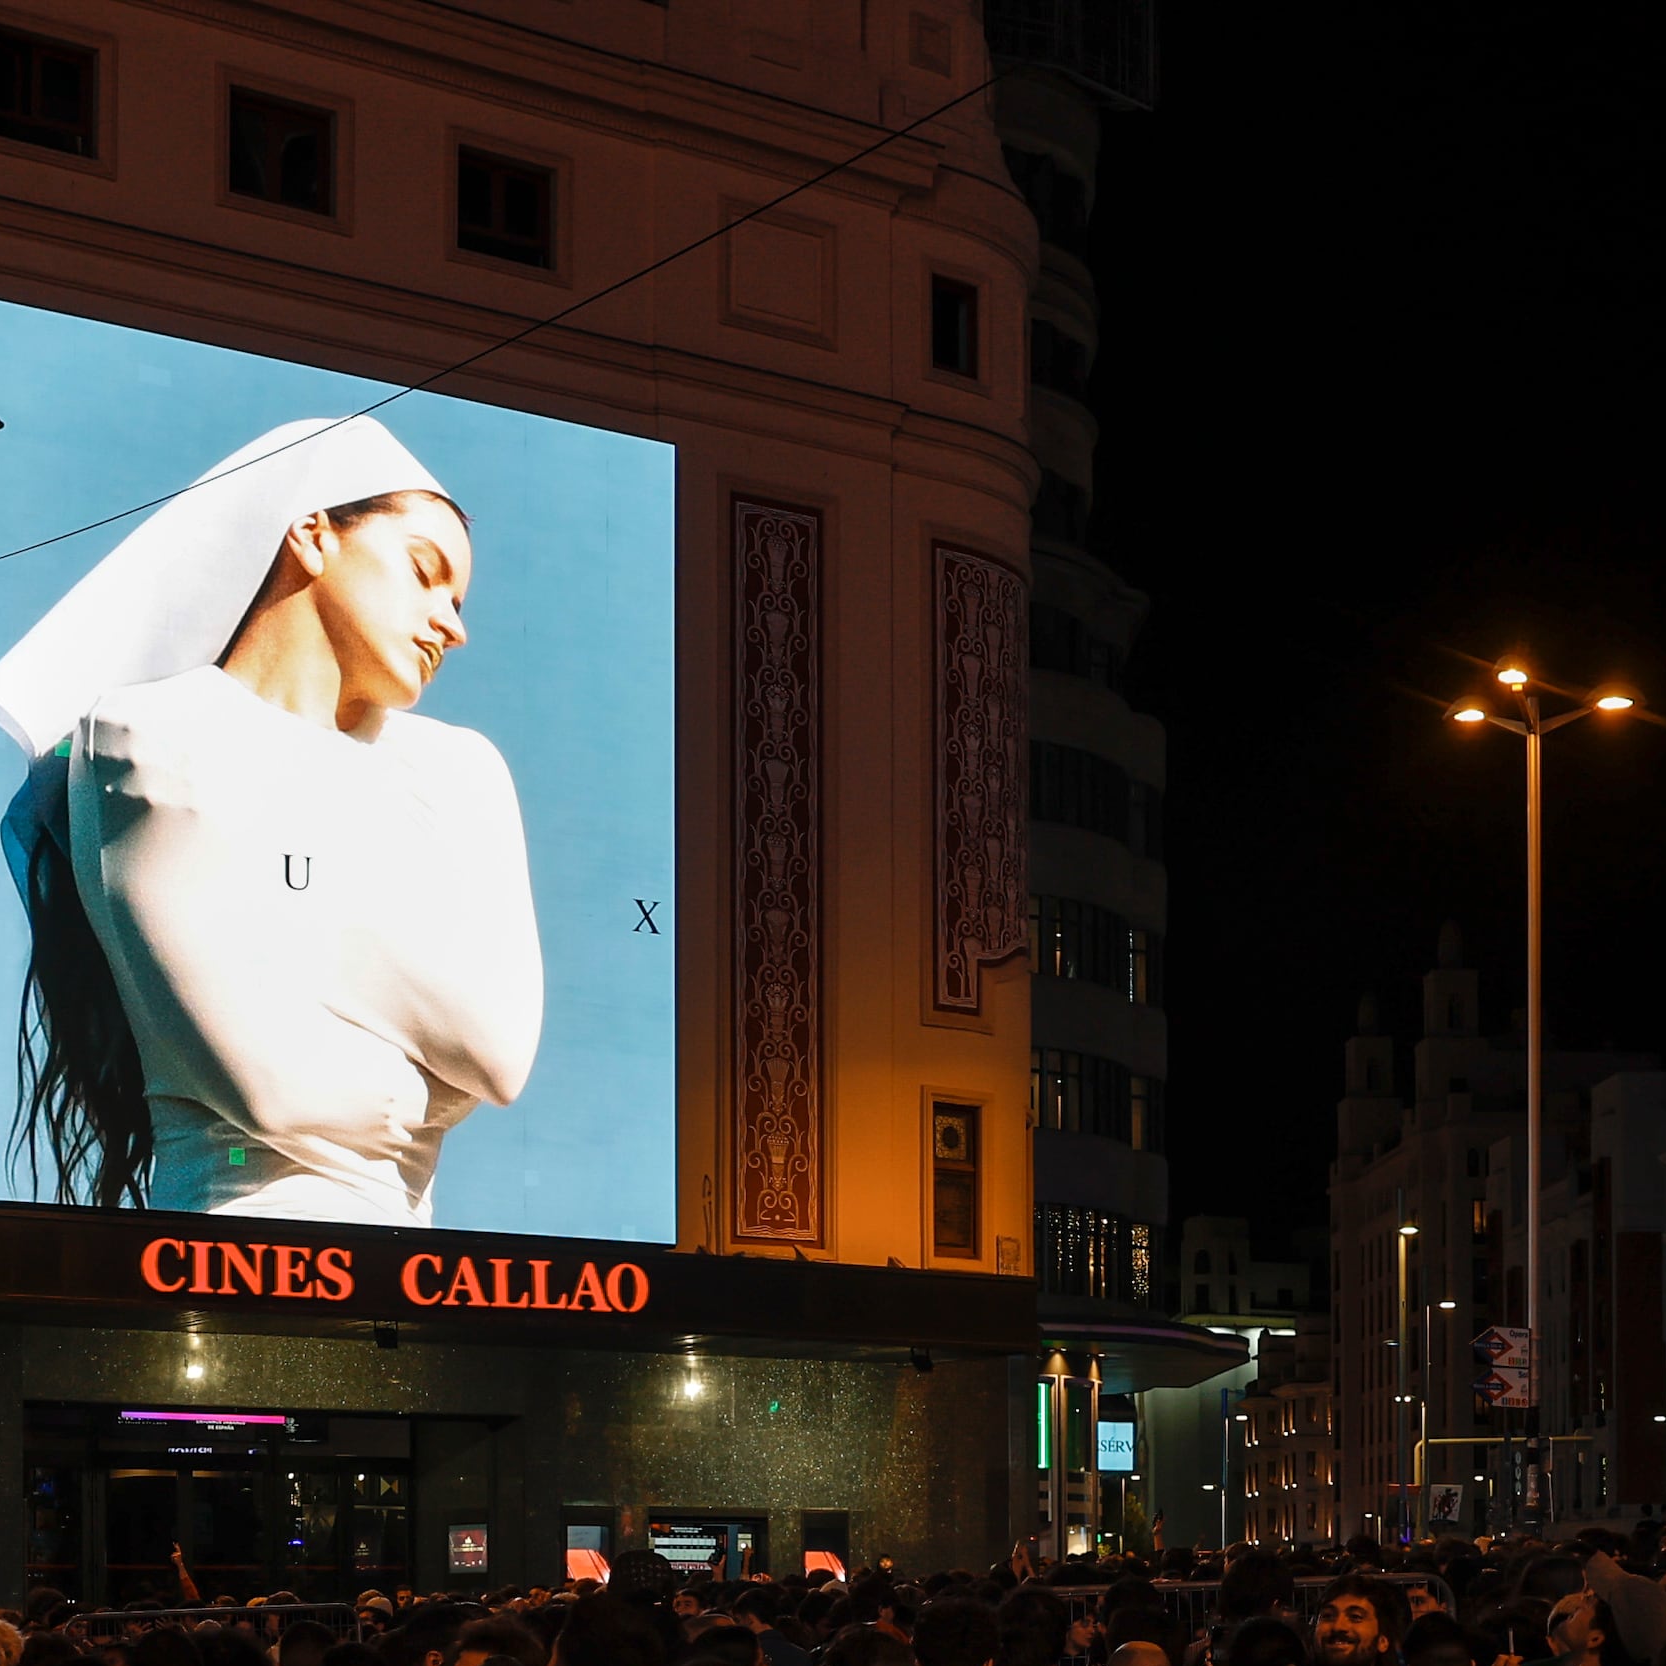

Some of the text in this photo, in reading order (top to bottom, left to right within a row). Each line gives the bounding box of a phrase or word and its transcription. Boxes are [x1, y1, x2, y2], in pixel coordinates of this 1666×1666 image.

[281, 853, 313, 891] U
[632, 898, 661, 935] X
[140, 1236, 651, 1314] CINES CALLAO
